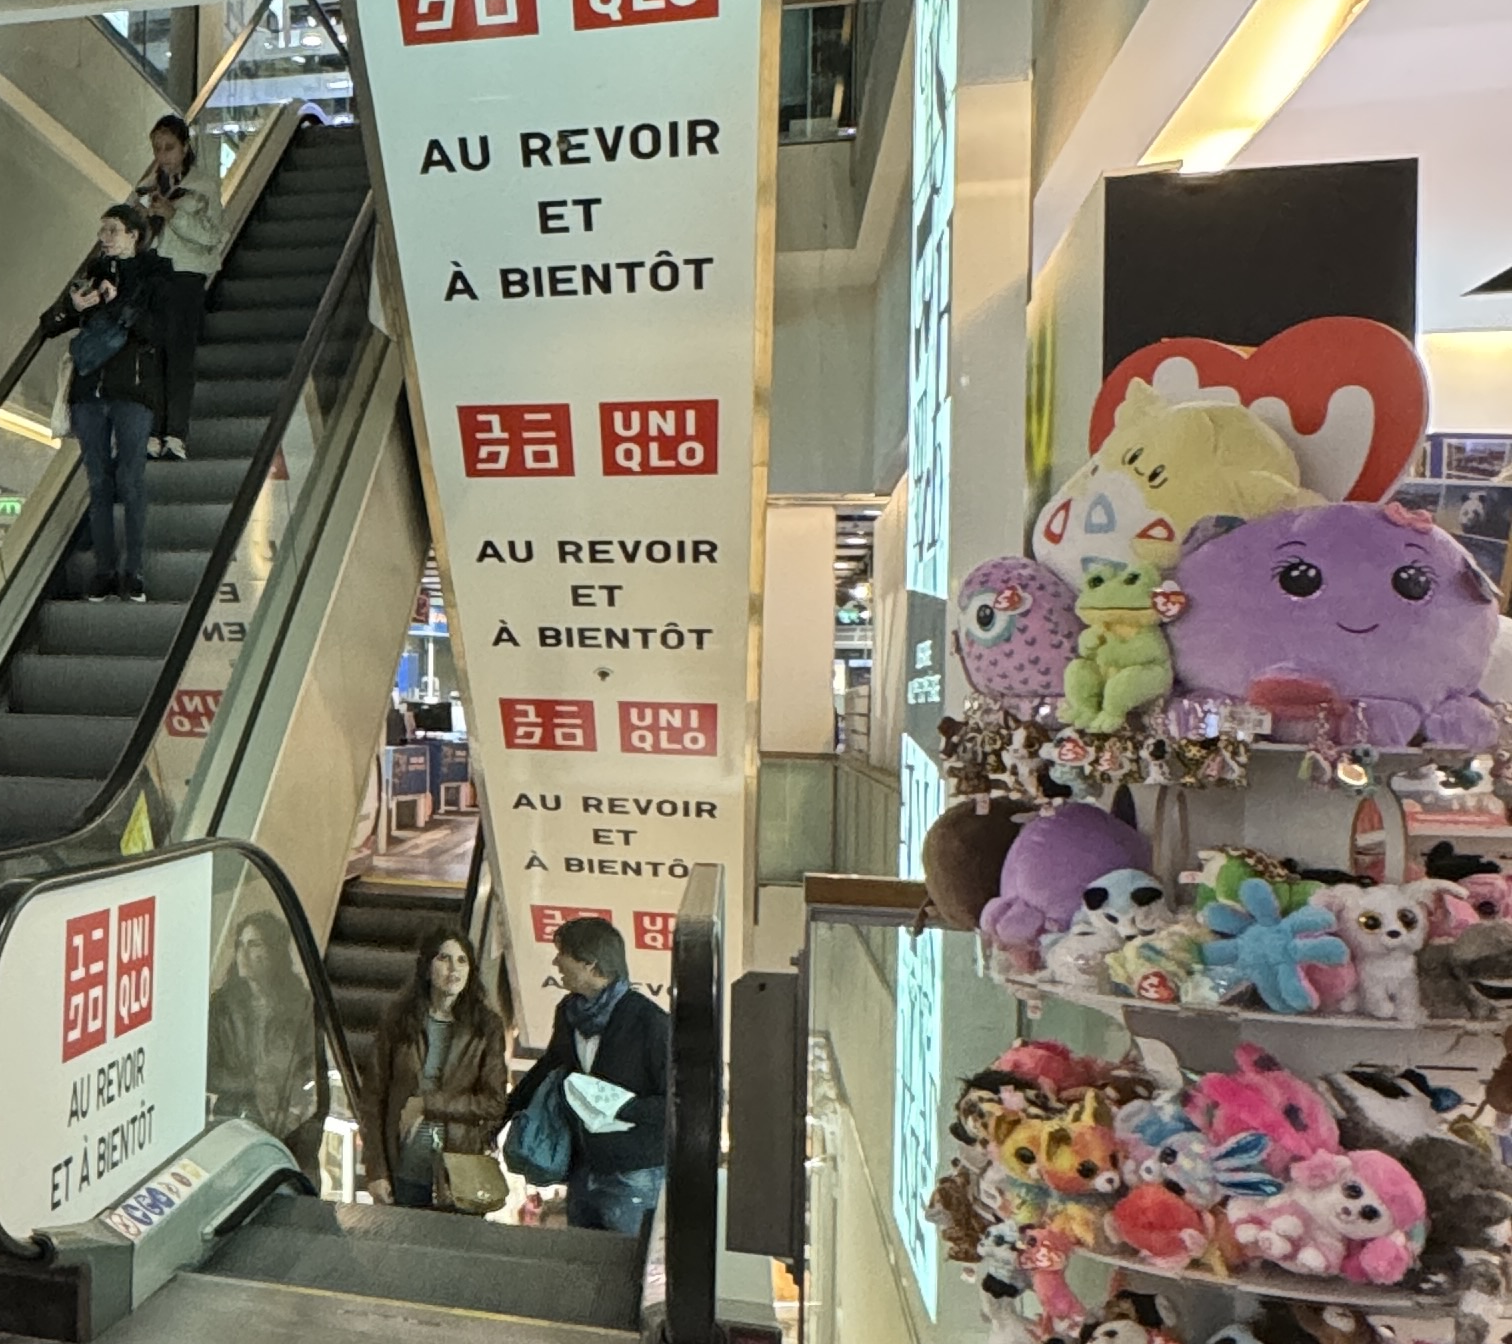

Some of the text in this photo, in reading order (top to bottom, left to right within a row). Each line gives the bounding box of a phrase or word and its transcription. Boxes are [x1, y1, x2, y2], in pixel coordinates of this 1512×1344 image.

[419, 118, 720, 175] AU REVOIR
[537, 197, 602, 234] ET
[444, 250, 714, 302] À BIENTÔT
[613, 409, 696, 437] UNI
[614, 440, 705, 472] QLO
[476, 539, 719, 564] AU REVOIR
[570, 584, 624, 607] ET
[491, 619, 714, 651] À BIENTÔT
[629, 707, 699, 728] UNI
[630, 730, 706, 751] QLO
[512, 793, 718, 819] AU REVOIR
[592, 828, 638, 846] ET
[524, 850, 689, 879] À BIENTÔ
[120, 914, 150, 963] UNI
[118, 966, 150, 1024] QLO
[67, 1046, 146, 1128] AU REVOIR
[50, 1099, 155, 1212] ET À BIENTÔT
